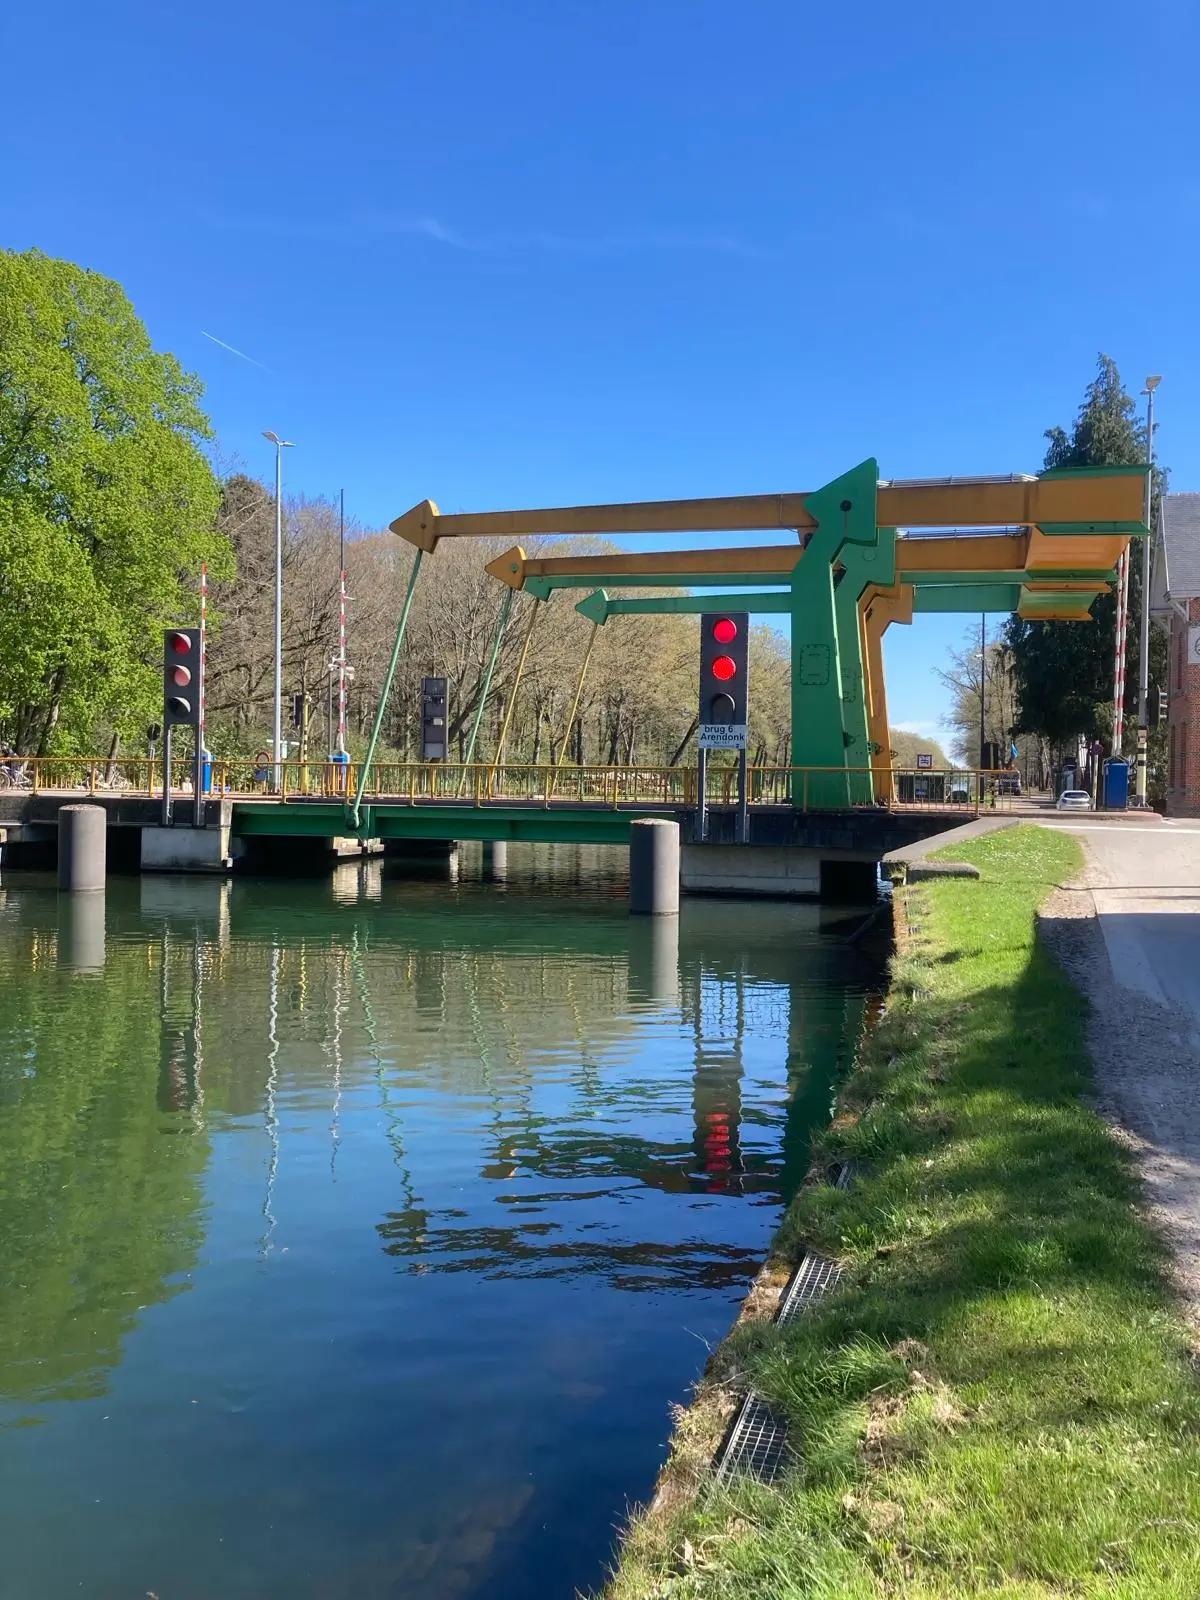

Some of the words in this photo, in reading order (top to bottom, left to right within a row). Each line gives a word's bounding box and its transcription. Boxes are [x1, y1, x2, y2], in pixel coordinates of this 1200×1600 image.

[704, 725, 725, 734] brug
[728, 725, 733, 733] 6
[700, 733, 745, 741] Arendonk
